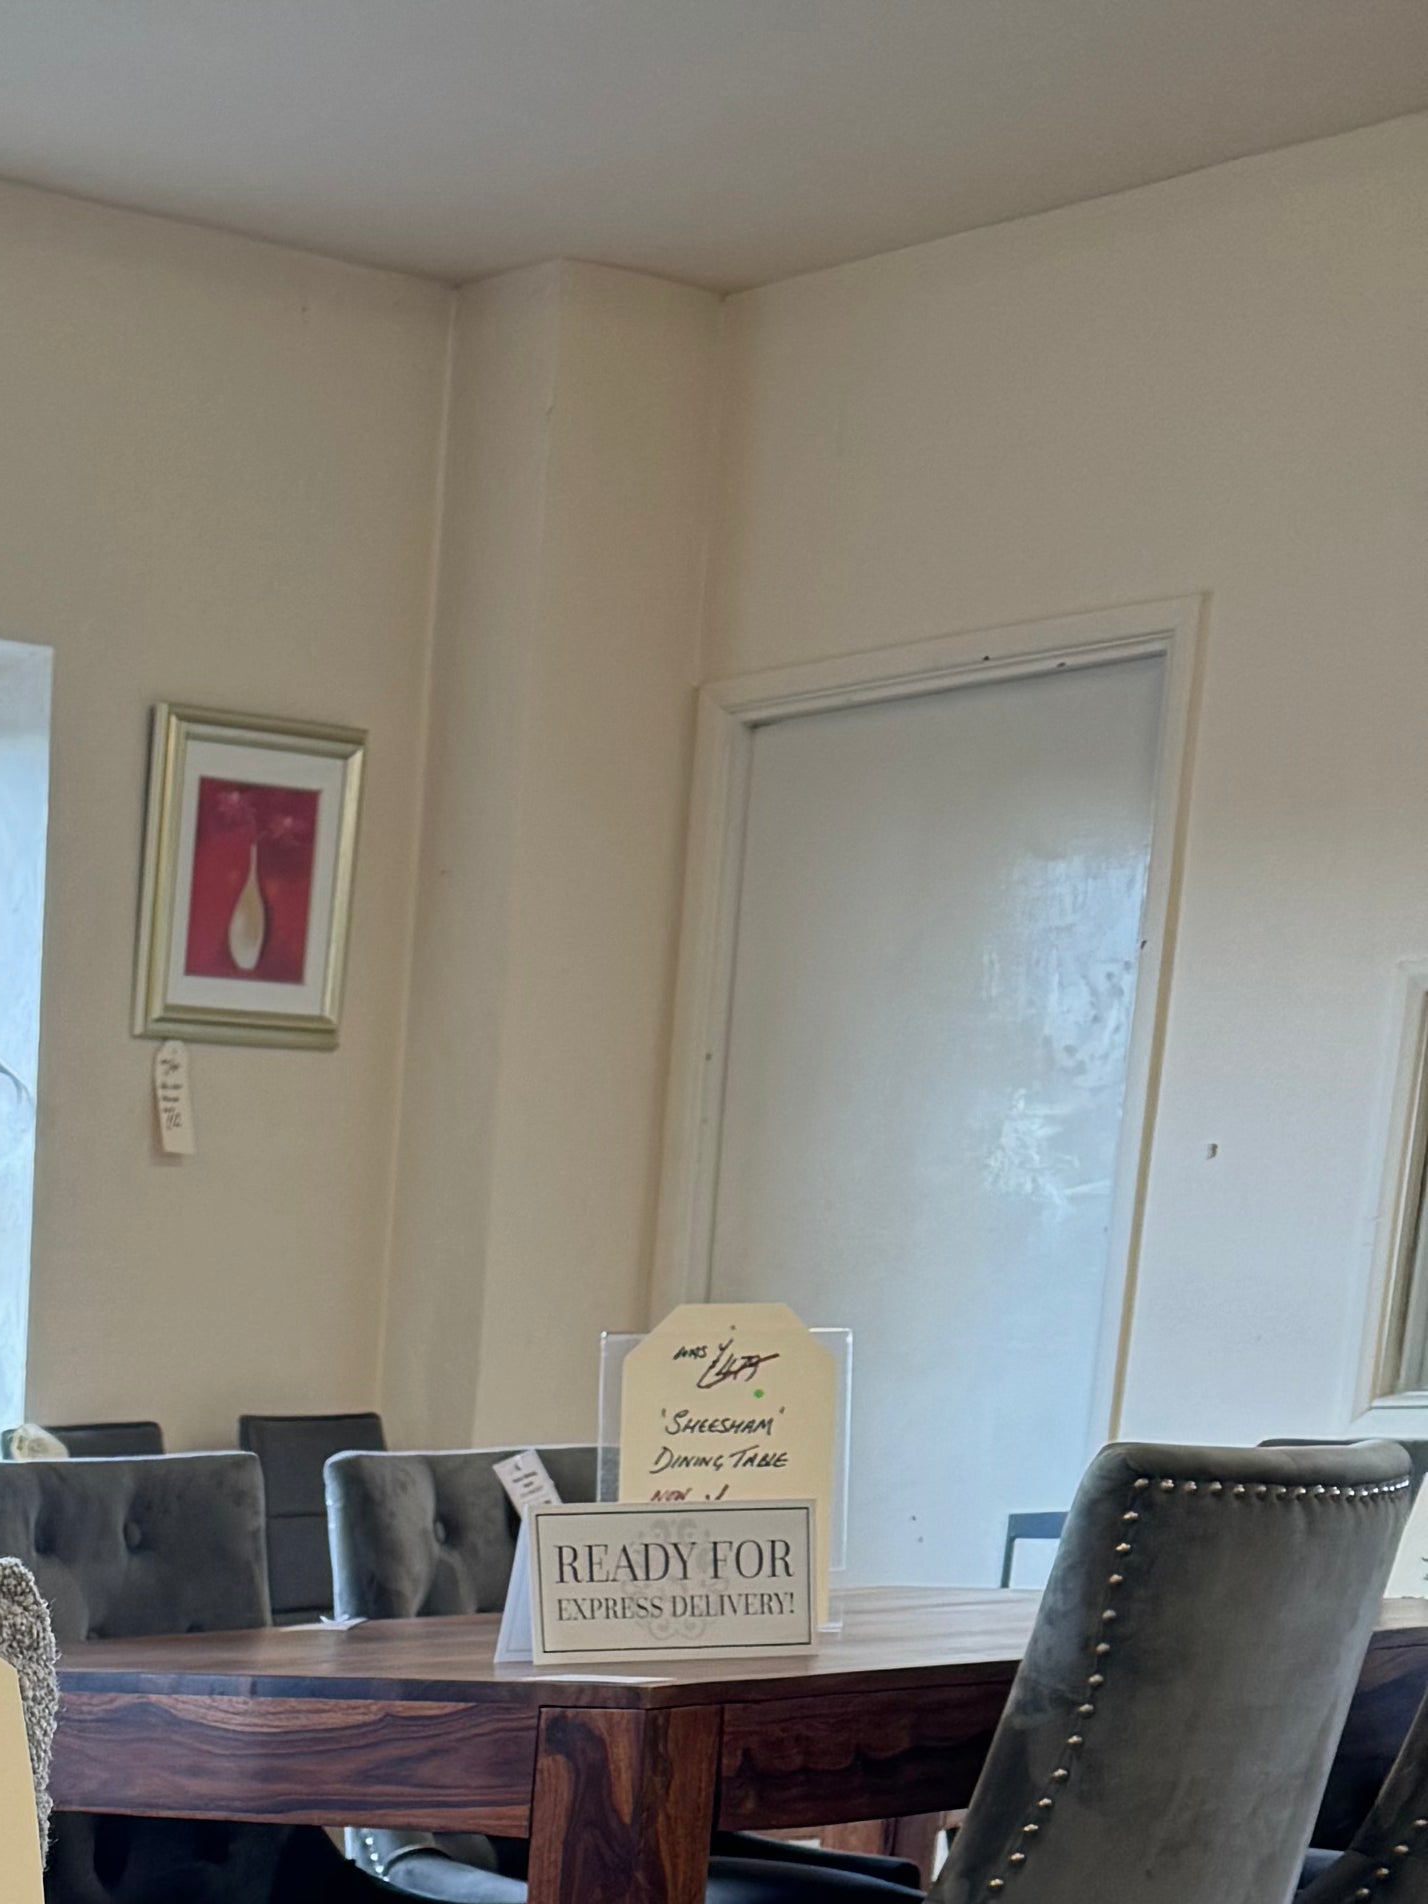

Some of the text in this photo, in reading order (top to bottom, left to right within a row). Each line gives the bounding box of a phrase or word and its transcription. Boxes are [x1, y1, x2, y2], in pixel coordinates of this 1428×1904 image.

[554, 1539, 796, 1585] READY FOR
[557, 1592, 796, 1622] EXPRESS DELIVERY!
